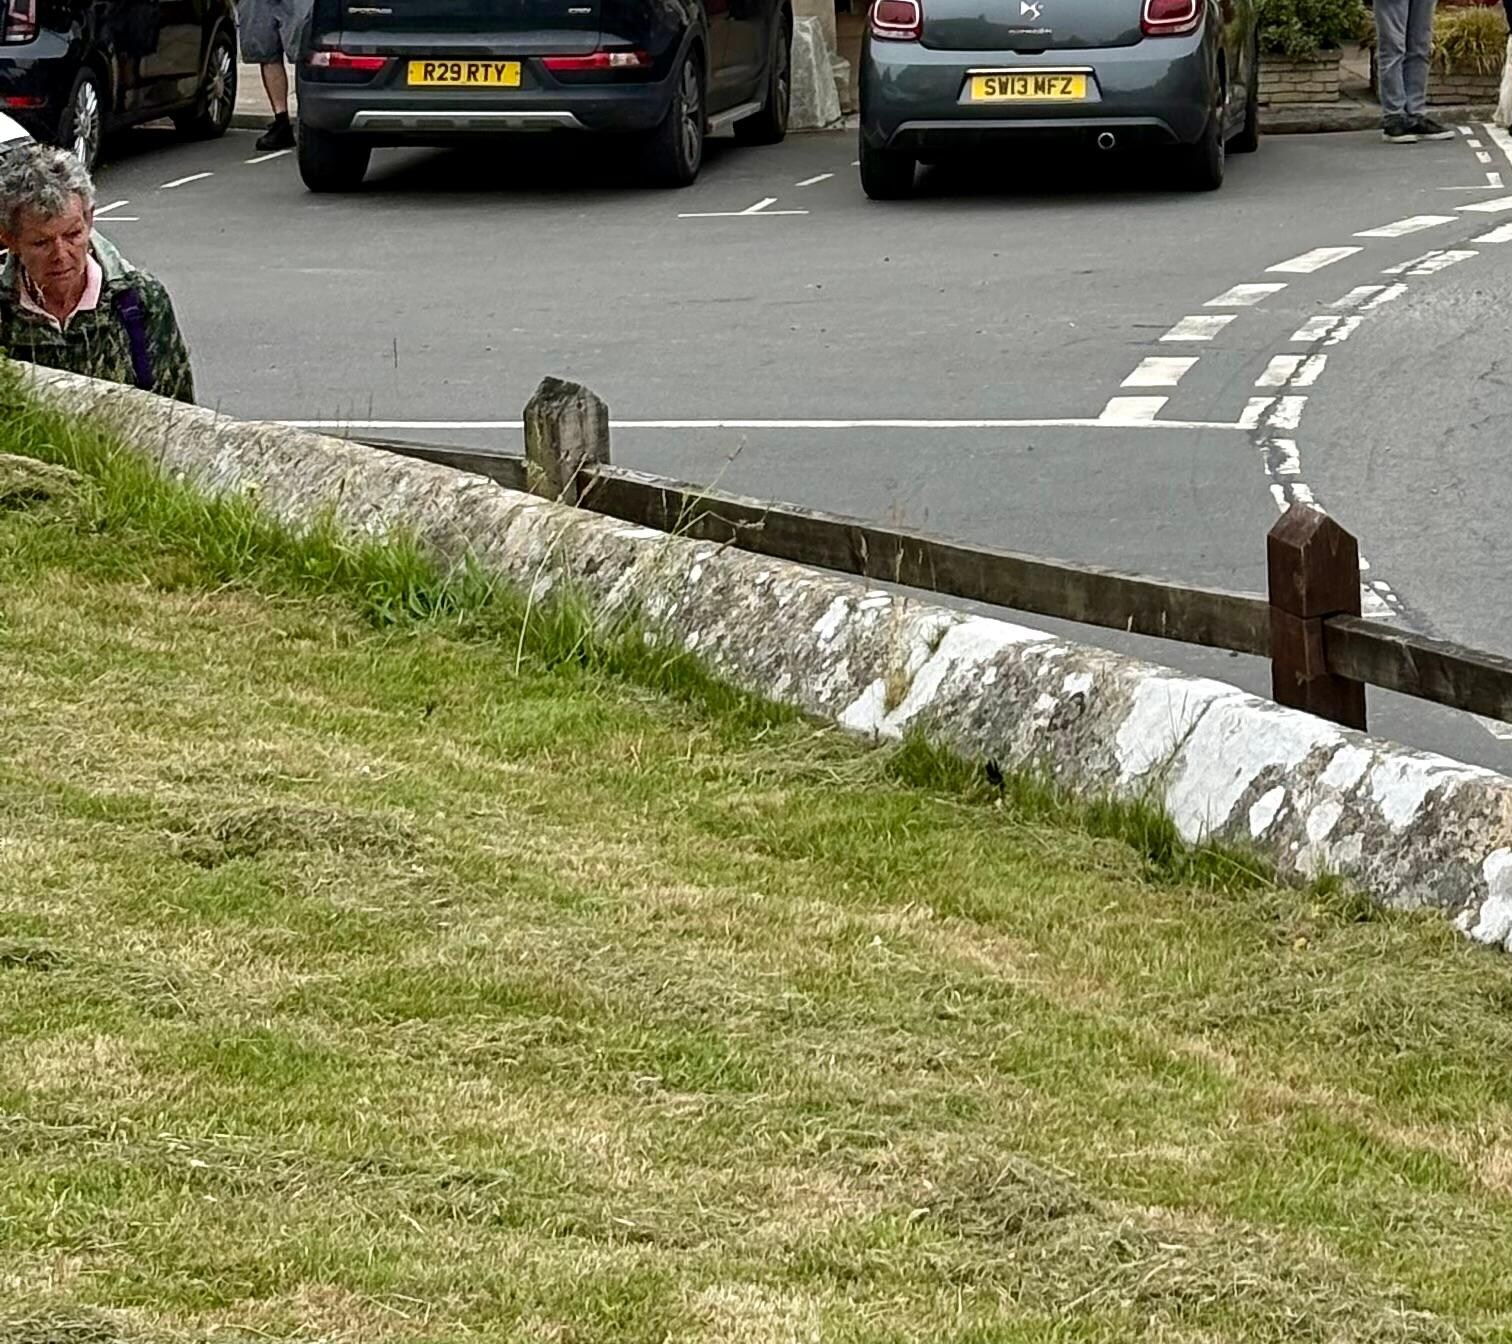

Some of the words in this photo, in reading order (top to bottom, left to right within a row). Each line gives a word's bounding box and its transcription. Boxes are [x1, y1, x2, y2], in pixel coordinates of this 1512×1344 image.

[423, 63, 462, 82] R29
[466, 63, 506, 82] RTY
[984, 77, 1028, 96] SW13
[1034, 76, 1073, 95] MFZ
